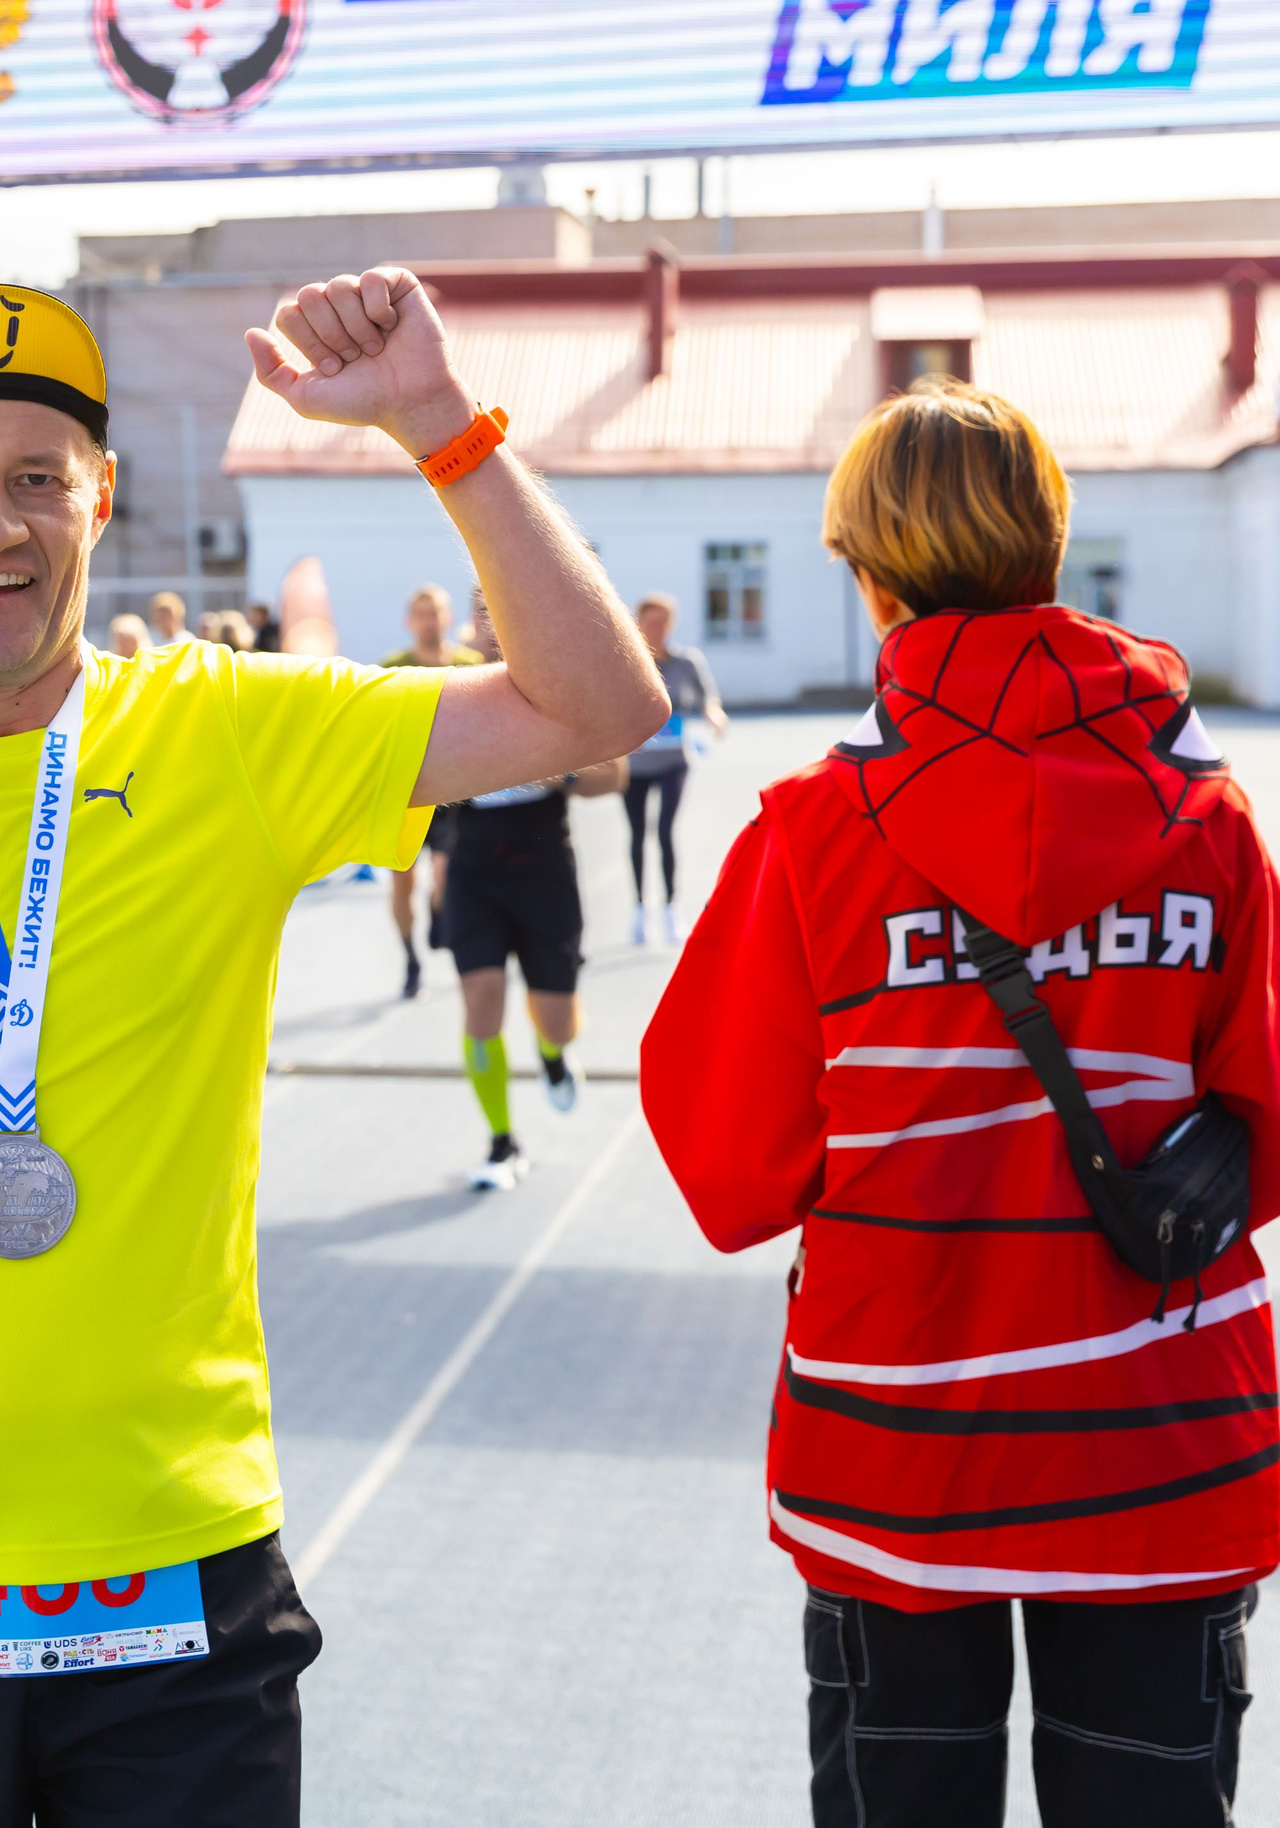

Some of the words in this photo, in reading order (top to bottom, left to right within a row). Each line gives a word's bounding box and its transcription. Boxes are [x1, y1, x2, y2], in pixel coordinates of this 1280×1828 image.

[35, 731, 68, 851] ДИНАМО
[18, 858, 50, 969] БЕЖИТ!
[54, 1638, 77, 1648] UDS
[63, 1657, 95, 1669] Effort
